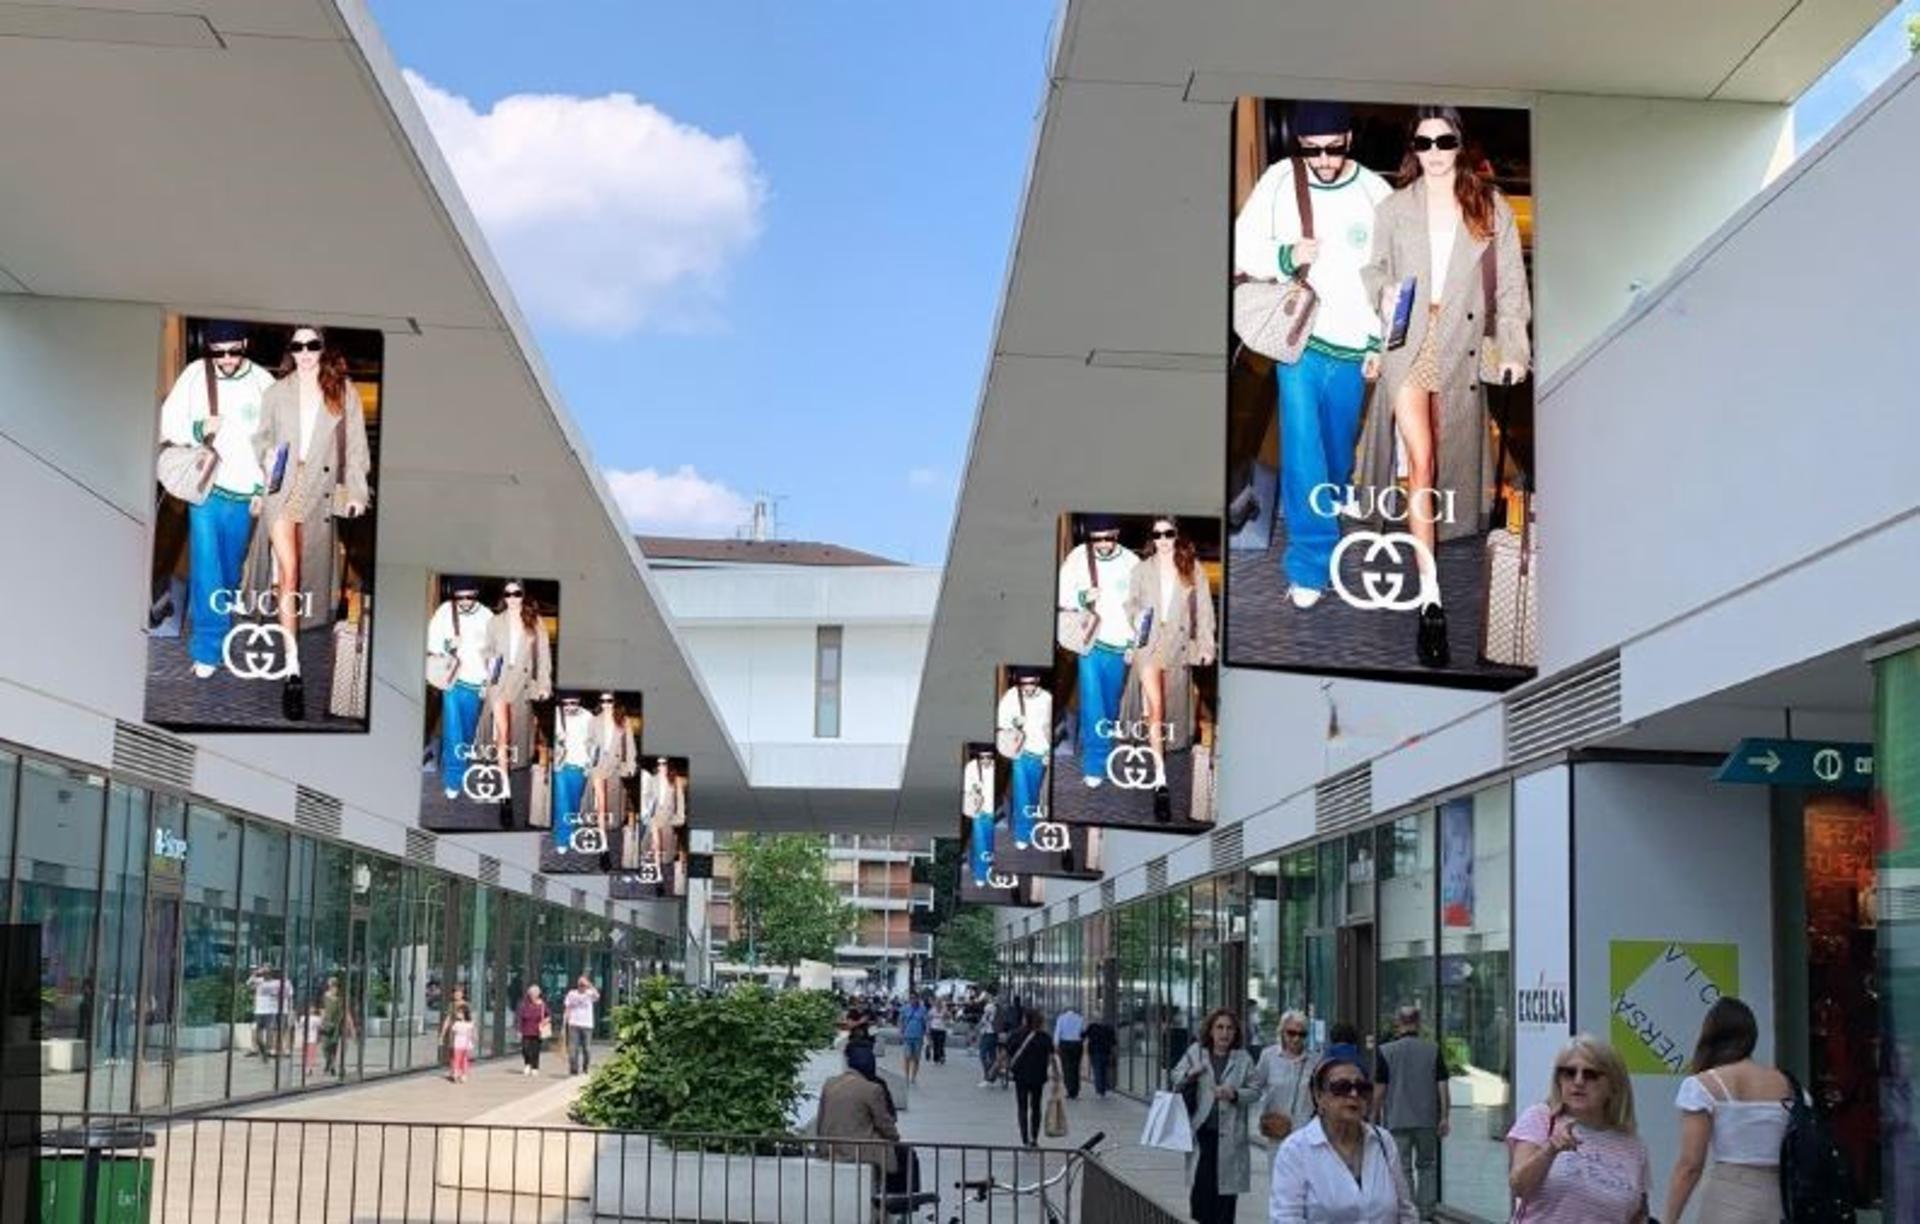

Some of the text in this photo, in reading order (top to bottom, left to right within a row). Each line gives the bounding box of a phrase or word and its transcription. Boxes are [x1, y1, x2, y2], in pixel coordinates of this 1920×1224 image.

[1309, 483, 1456, 523] GUCCI
[209, 589, 313, 617] GUCCI
[1095, 719, 1174, 741] GUCCI
[454, 743, 518, 763] GUCCI
[1666, 941, 1723, 1005] VIC
